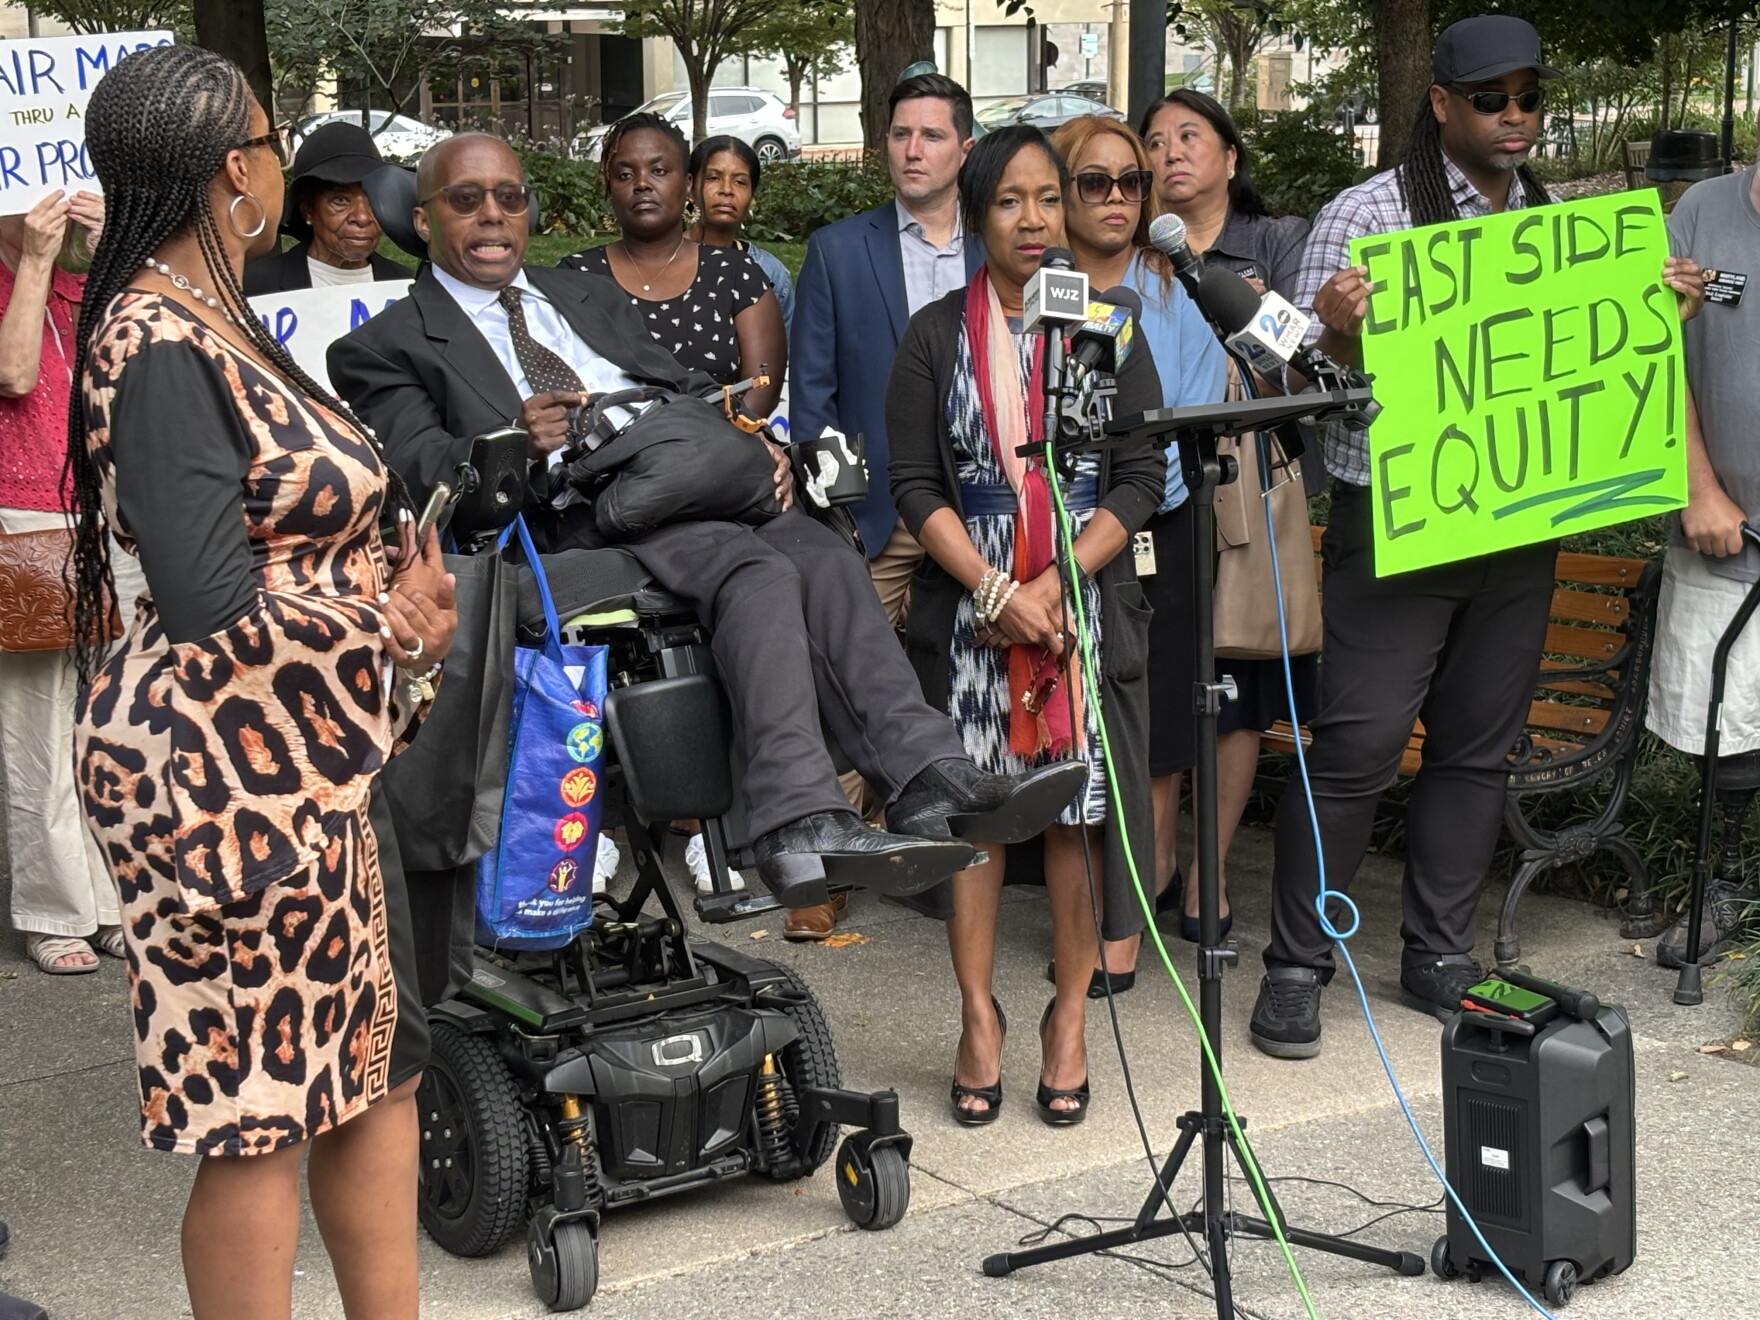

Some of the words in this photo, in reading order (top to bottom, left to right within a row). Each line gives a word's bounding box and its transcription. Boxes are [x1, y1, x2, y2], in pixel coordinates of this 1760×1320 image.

[9, 108, 54, 126] THRU
[66, 103, 81, 119] A
[1360, 227, 1482, 335] EAST
[1505, 206, 1656, 284] SIDE
[1050, 286, 1079, 301] WJZ
[1259, 314, 1287, 344] 2
[1279, 317, 1301, 348] WMAR
[1435, 284, 1672, 414] NEEDS
[1379, 354, 1676, 540] EQUITY!
[523, 908, 546, 916] make
[538, 900, 554, 910] you
[554, 898, 565, 906] for
